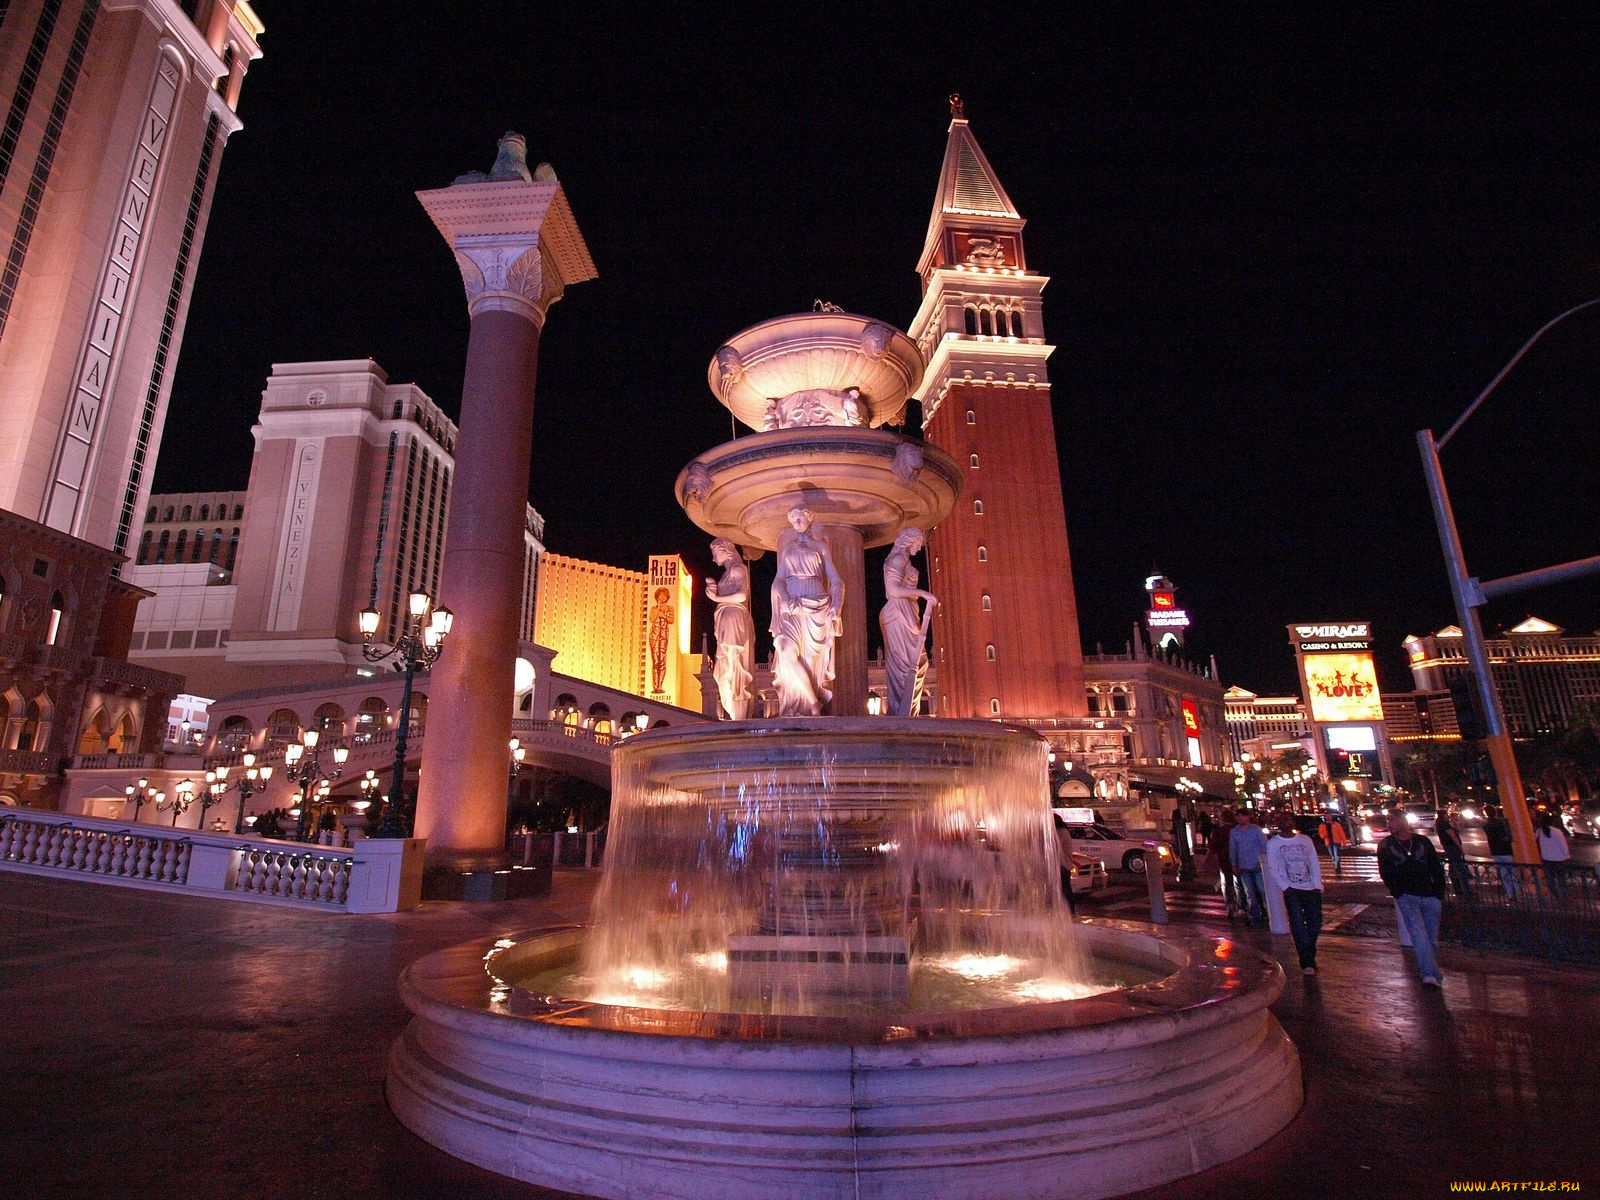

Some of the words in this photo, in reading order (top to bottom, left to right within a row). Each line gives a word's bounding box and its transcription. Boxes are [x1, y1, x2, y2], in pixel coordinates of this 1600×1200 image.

[76, 119, 164, 433] VENETIAN
[284, 482, 310, 592] VENEZIA
[650, 559, 676, 576] Rita
[651, 576, 676, 586] Rudner
[1313, 623, 1368, 638] MIRAGE
[1325, 685, 1364, 697] LOVE
[1348, 753, 1362, 770] JET
